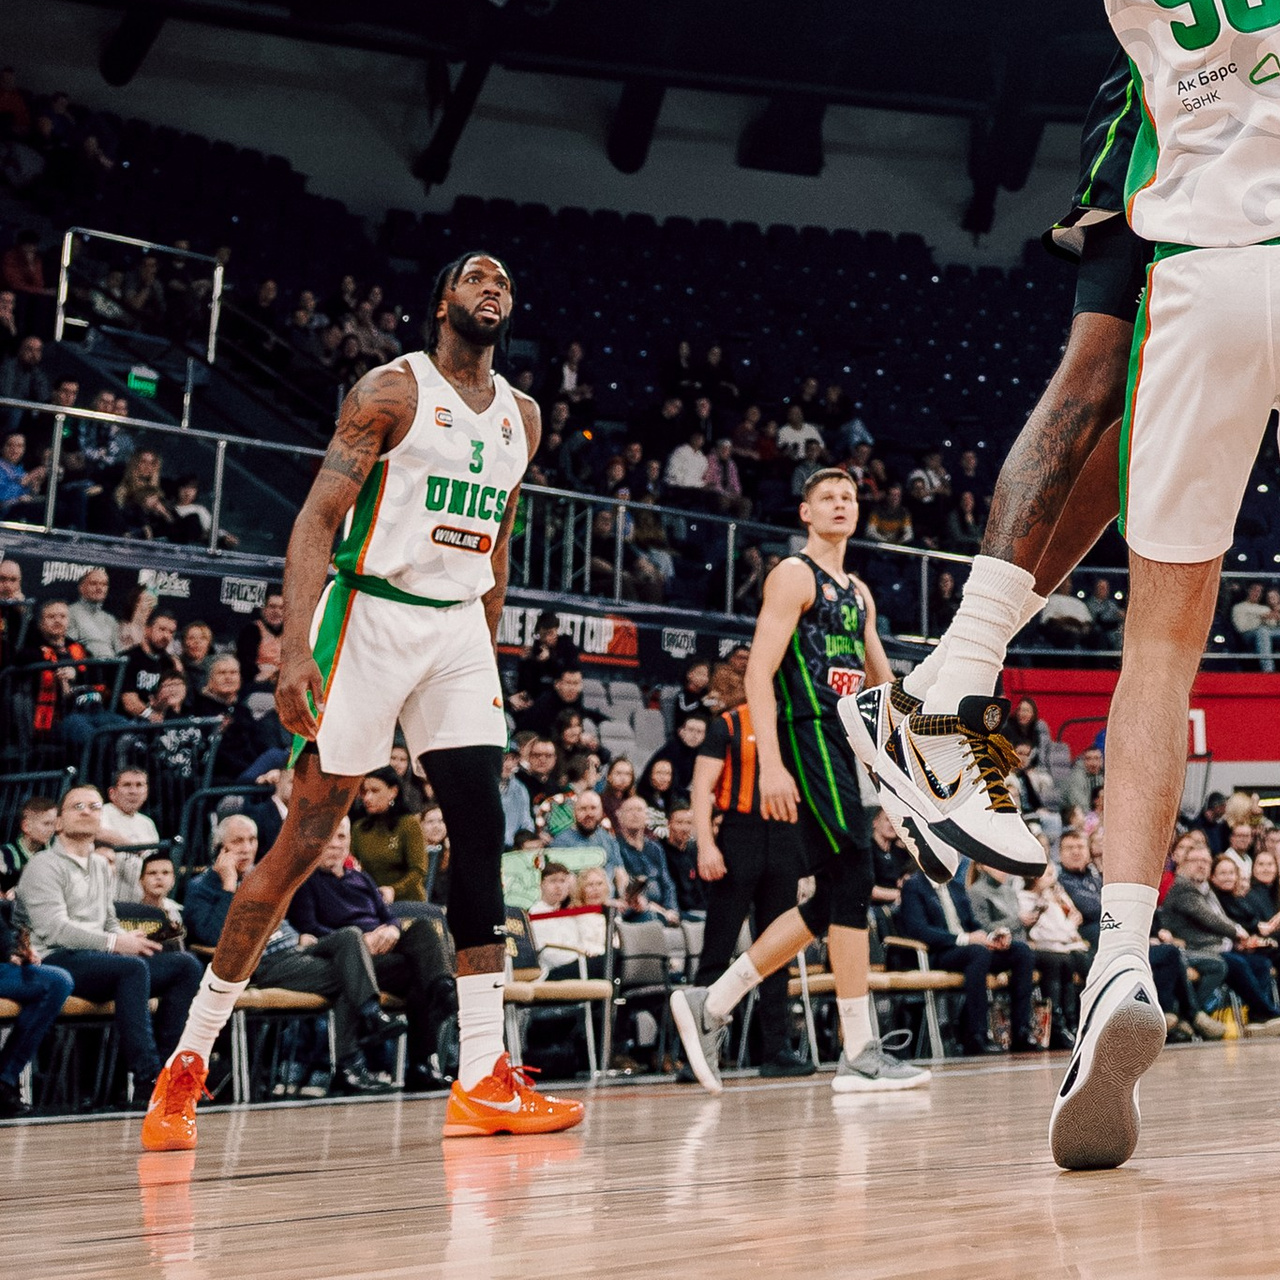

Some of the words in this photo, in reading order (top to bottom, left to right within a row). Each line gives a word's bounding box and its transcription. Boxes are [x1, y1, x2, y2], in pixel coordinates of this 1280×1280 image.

[1176, 77, 1197, 96] Ак
[1197, 61, 1239, 88] Барс
[469, 439, 484, 474] 3
[425, 475, 507, 523] UNICS
[434, 528, 481, 549] WINLINE
